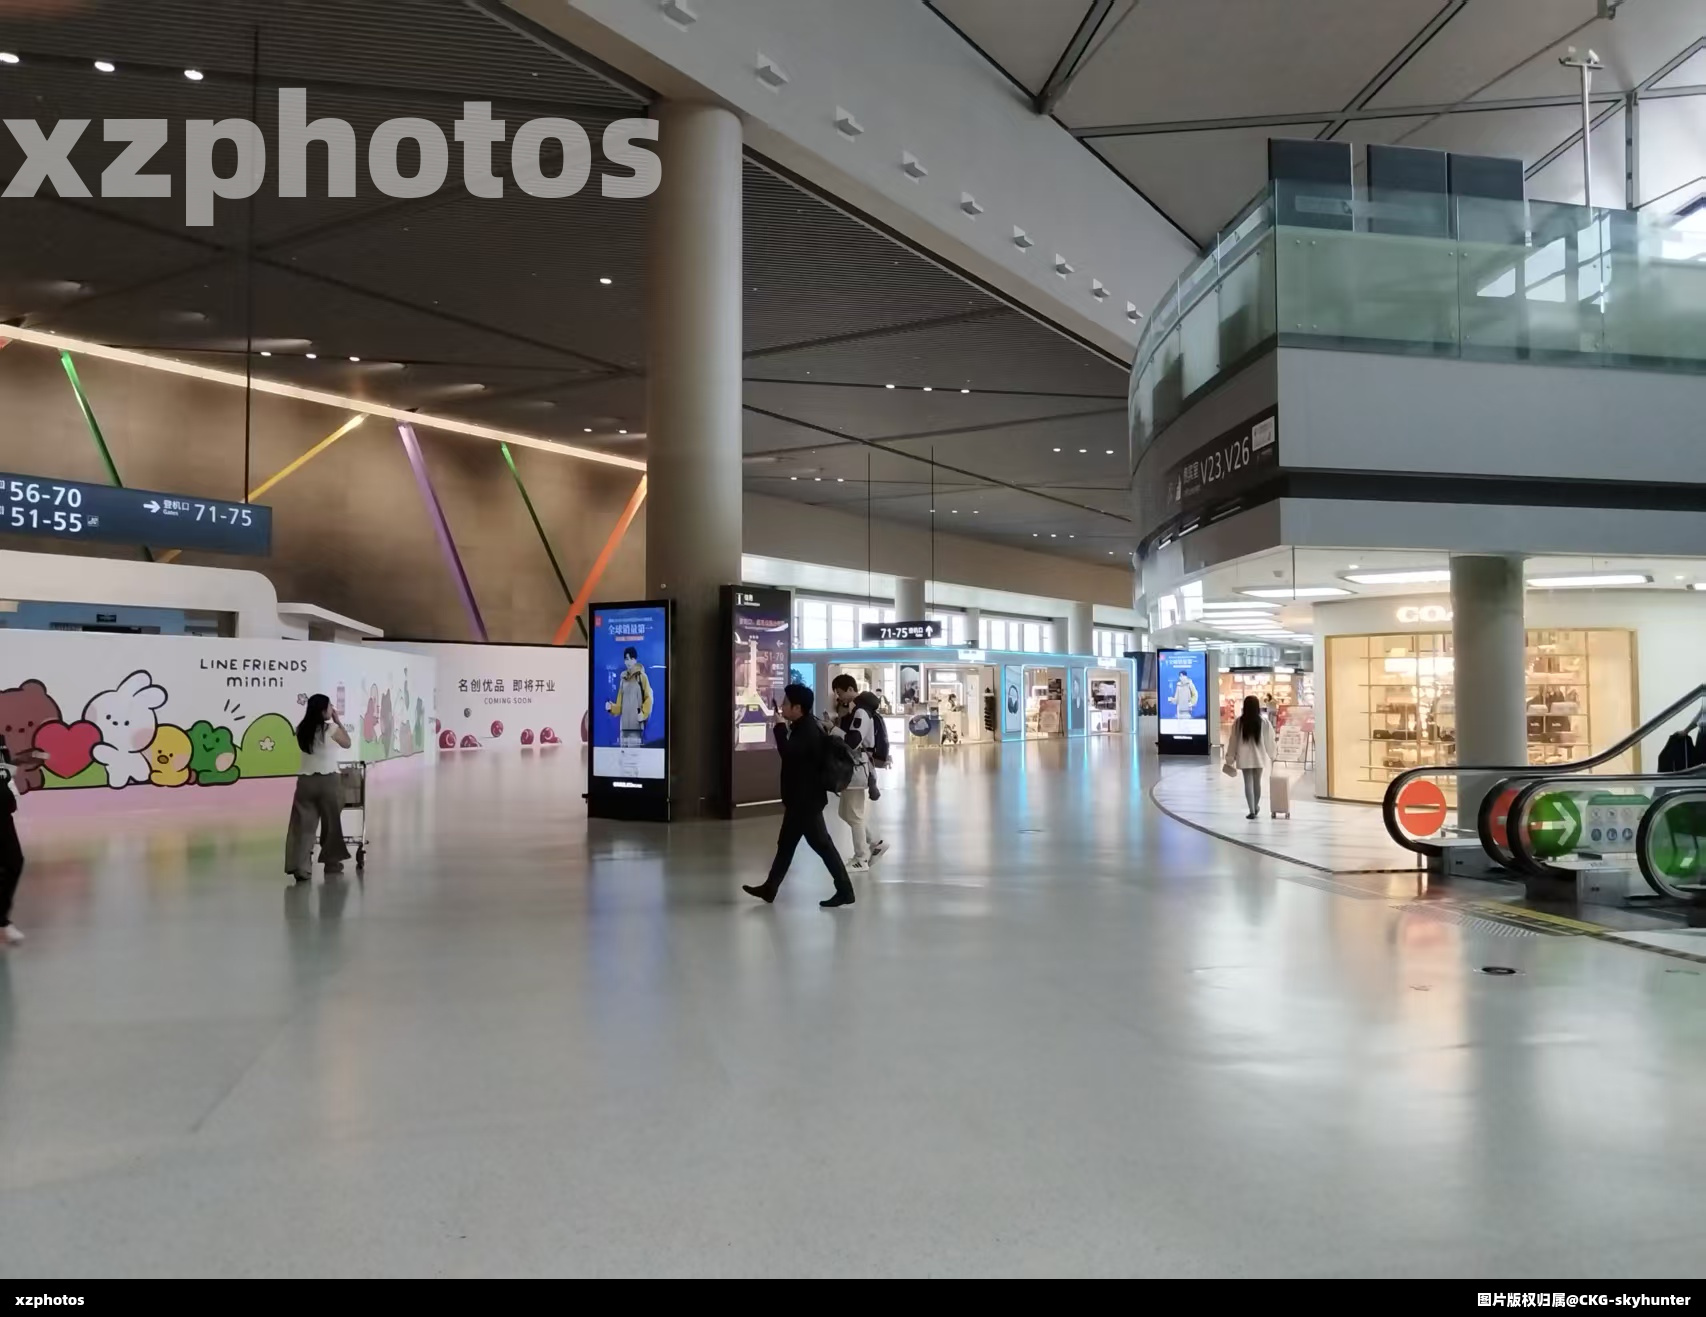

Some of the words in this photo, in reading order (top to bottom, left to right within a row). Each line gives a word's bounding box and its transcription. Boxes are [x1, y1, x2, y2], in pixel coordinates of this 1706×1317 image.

[1200, 436, 1250, 485] V23,V26
[10, 481, 82, 508] 56-70
[11, 507, 82, 533] 51-55
[163, 499, 190, 511] 登机口
[194, 504, 253, 527] 71-75
[1396, 605, 1454, 623] CO
[880, 627, 908, 638] 71-75
[200, 658, 238, 671] LINE
[243, 659, 308, 672] FRIENDS
[226, 675, 284, 688] minini
[458, 678, 505, 693] 名创优品
[512, 679, 556, 692] 即将开业
[484, 697, 511, 705] COMING
